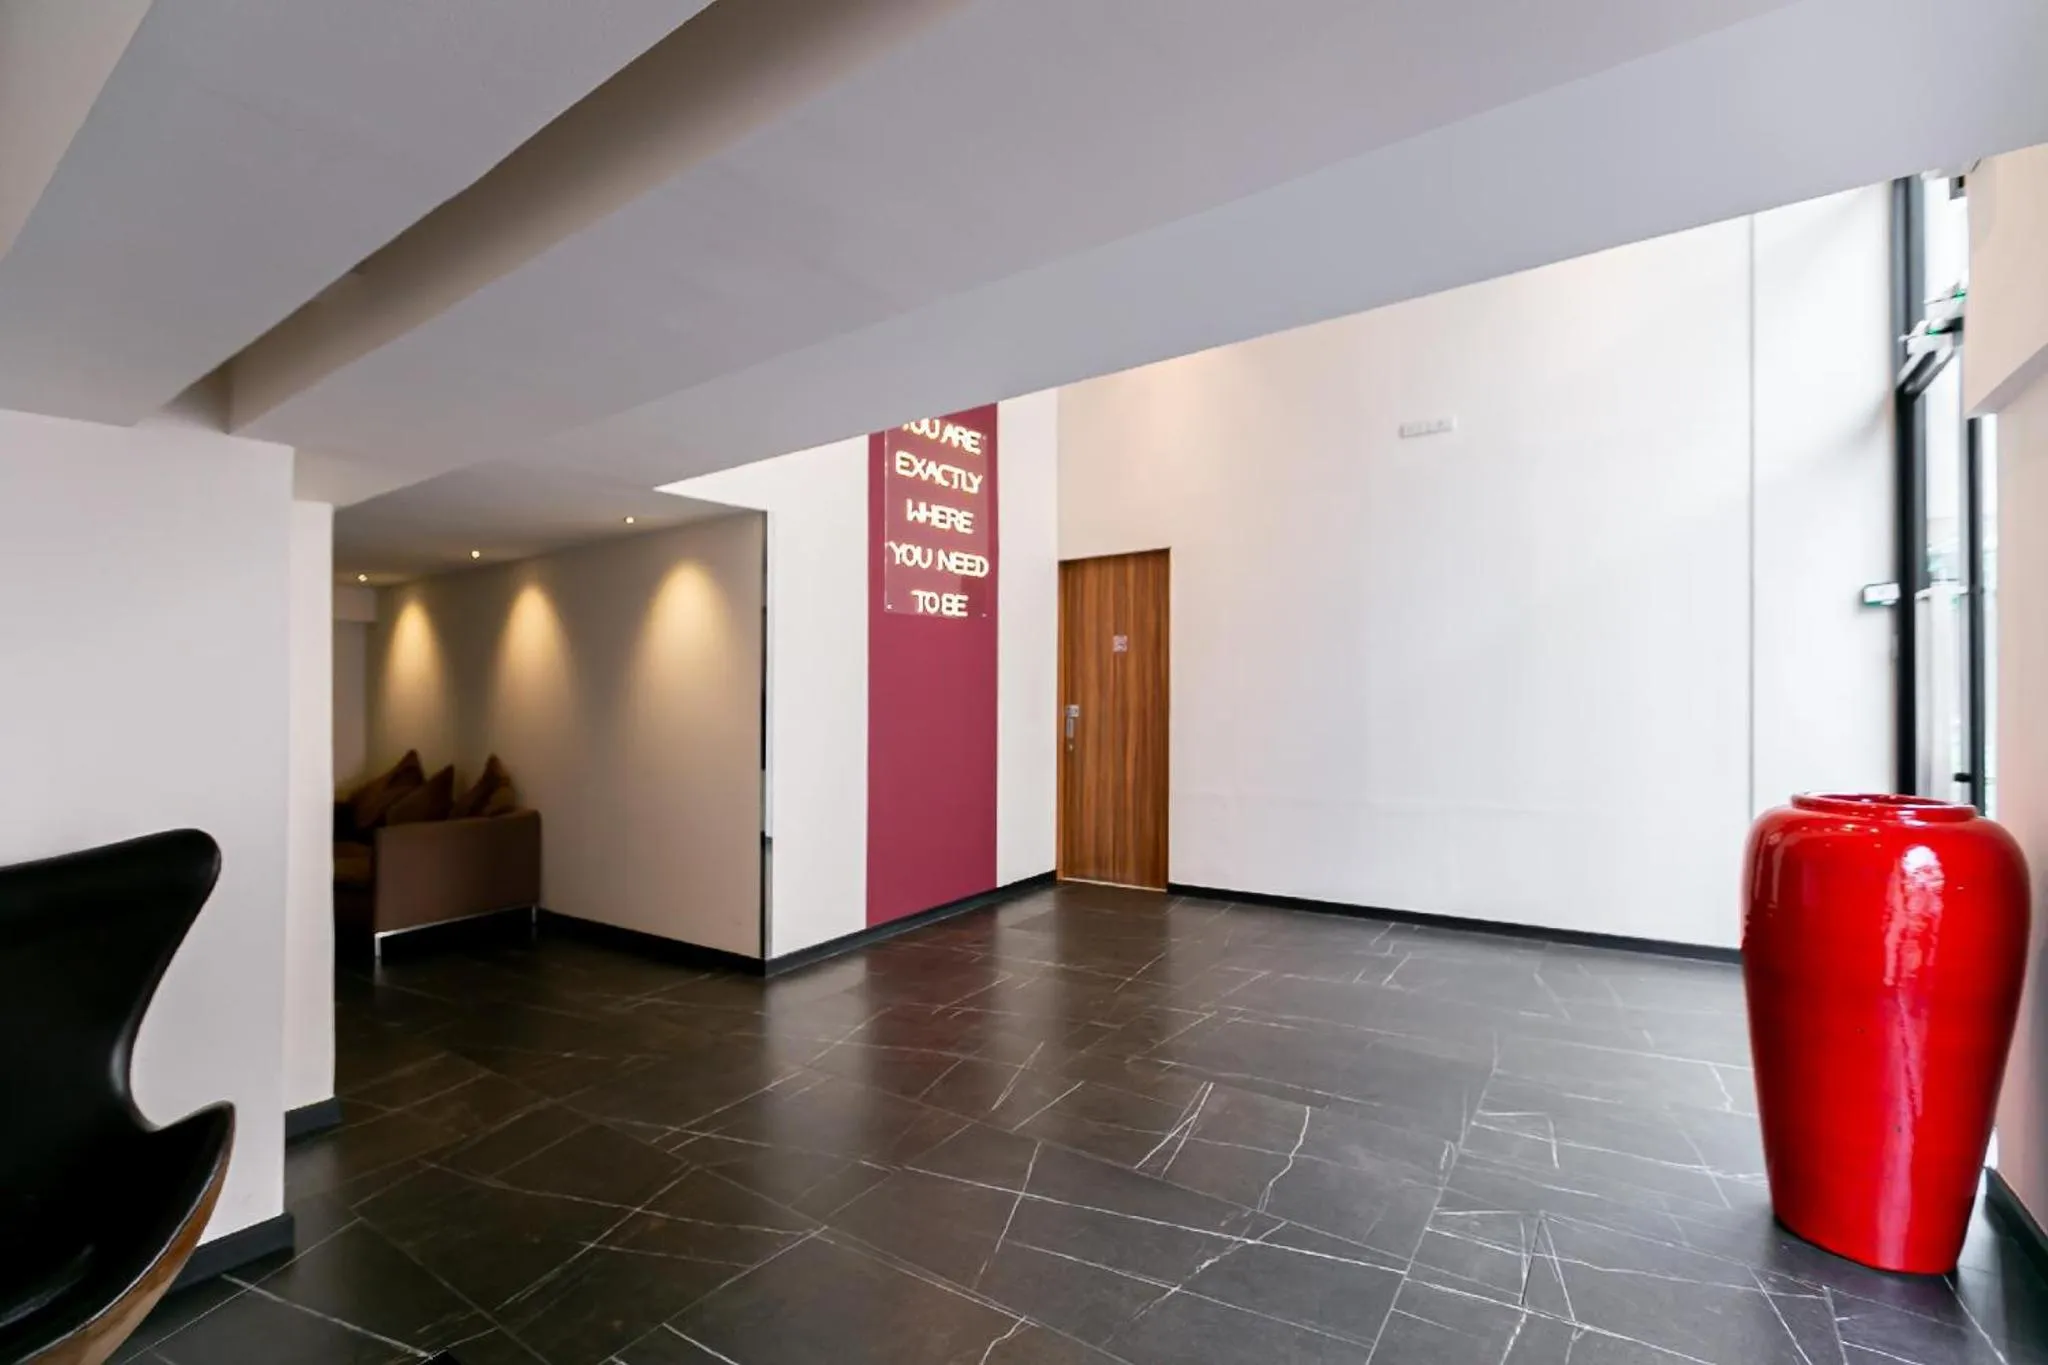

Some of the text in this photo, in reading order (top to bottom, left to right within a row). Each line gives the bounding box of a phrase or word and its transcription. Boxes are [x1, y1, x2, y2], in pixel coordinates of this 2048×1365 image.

[902, 418, 982, 455] OU ARE
[895, 451, 983, 494] EXACTLY
[906, 499, 974, 534] WHERE
[888, 541, 989, 578] YOU NEED
[911, 590, 969, 617] TO BE
